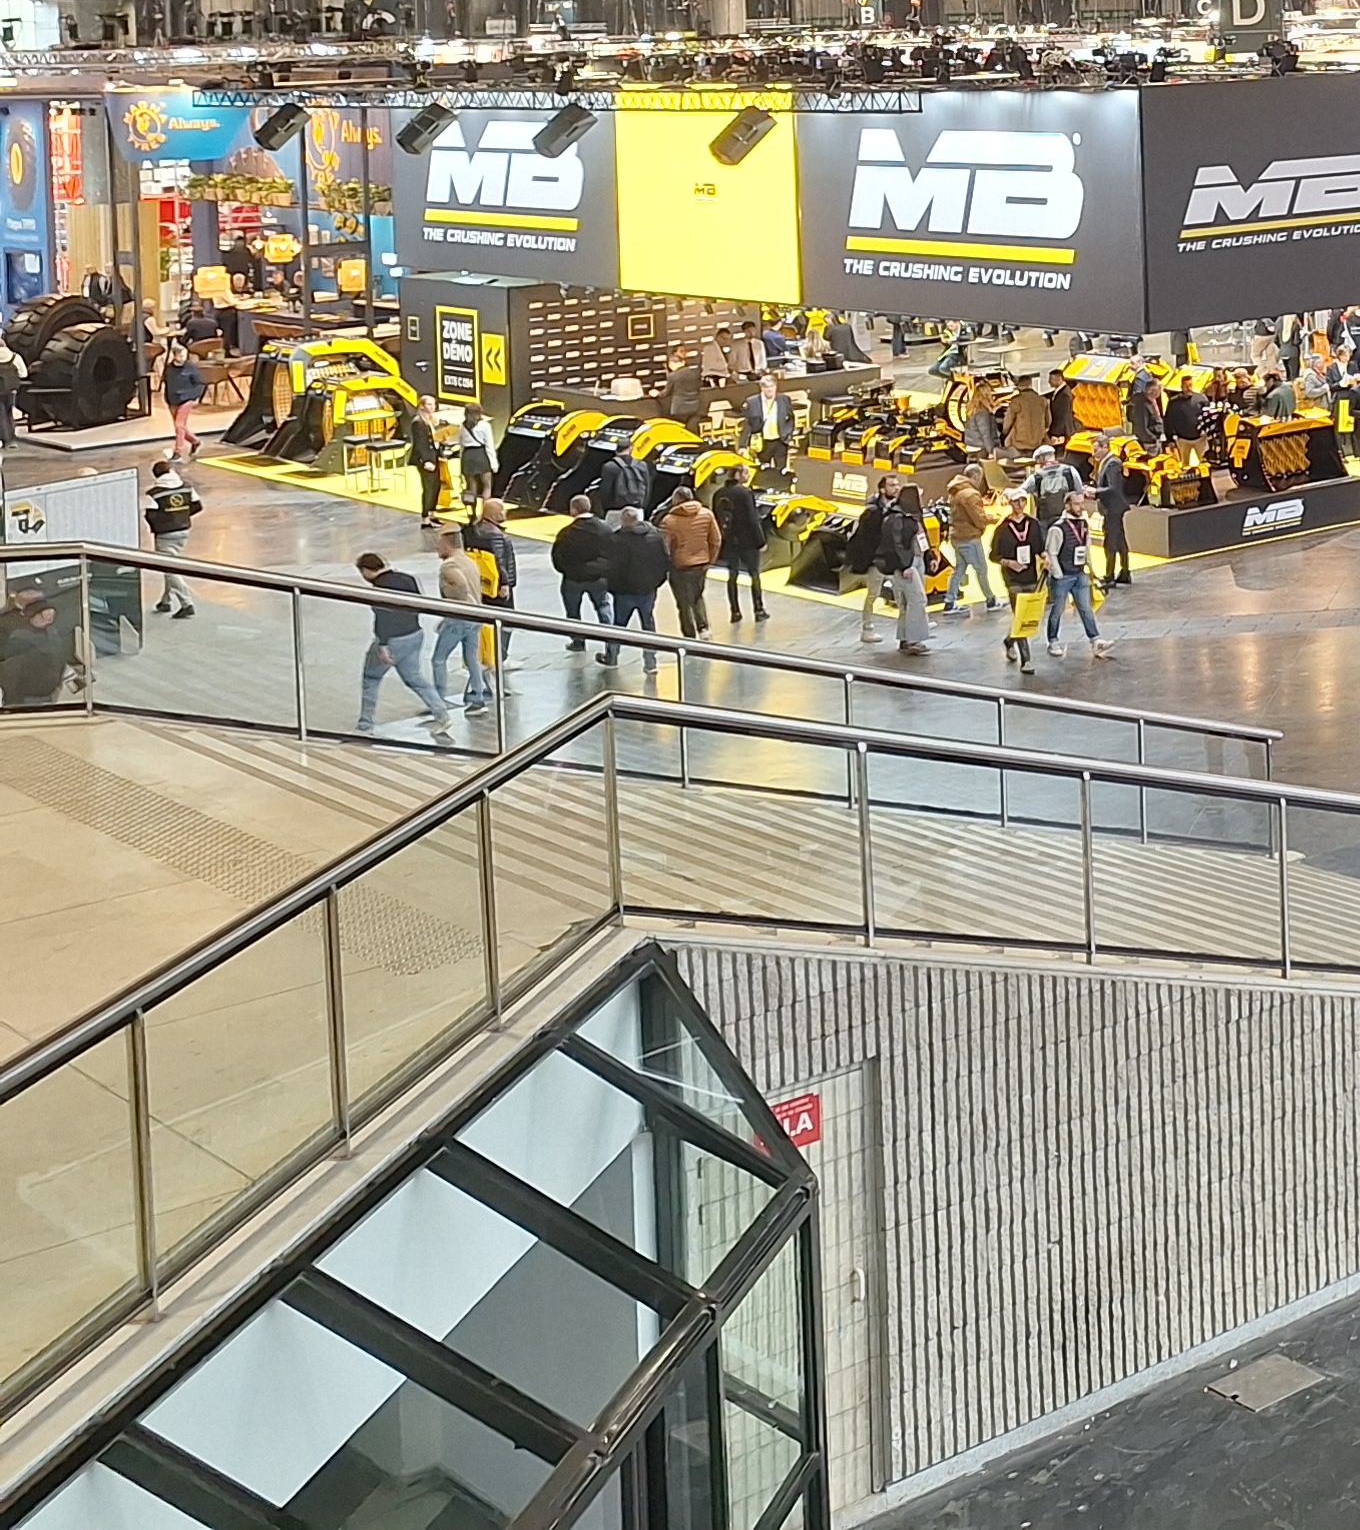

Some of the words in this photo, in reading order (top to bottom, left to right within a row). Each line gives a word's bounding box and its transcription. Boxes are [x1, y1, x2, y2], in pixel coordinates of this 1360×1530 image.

[860, 7, 875, 24] B
[1197, 0, 1213, 15] C
[341, 119, 384, 150] Alwys.
[426, 120, 585, 211] MB
[848, 127, 1085, 240] MB
[423, 226, 445, 242] THE
[446, 228, 505, 246] CRUSHING
[507, 234, 577, 253] EVOLUTION
[1176, 241, 1206, 254] THE
[1210, 231, 1288, 250] CRUSHING
[843, 257, 874, 275] THE
[878, 261, 964, 283] CRUSHING
[968, 267, 1072, 290] EVOLUTION
[442, 319, 473, 342] ZONE
[442, 338, 474, 364] DÉMO
[832, 471, 868, 493] MB
[1243, 498, 1305, 528] MB
